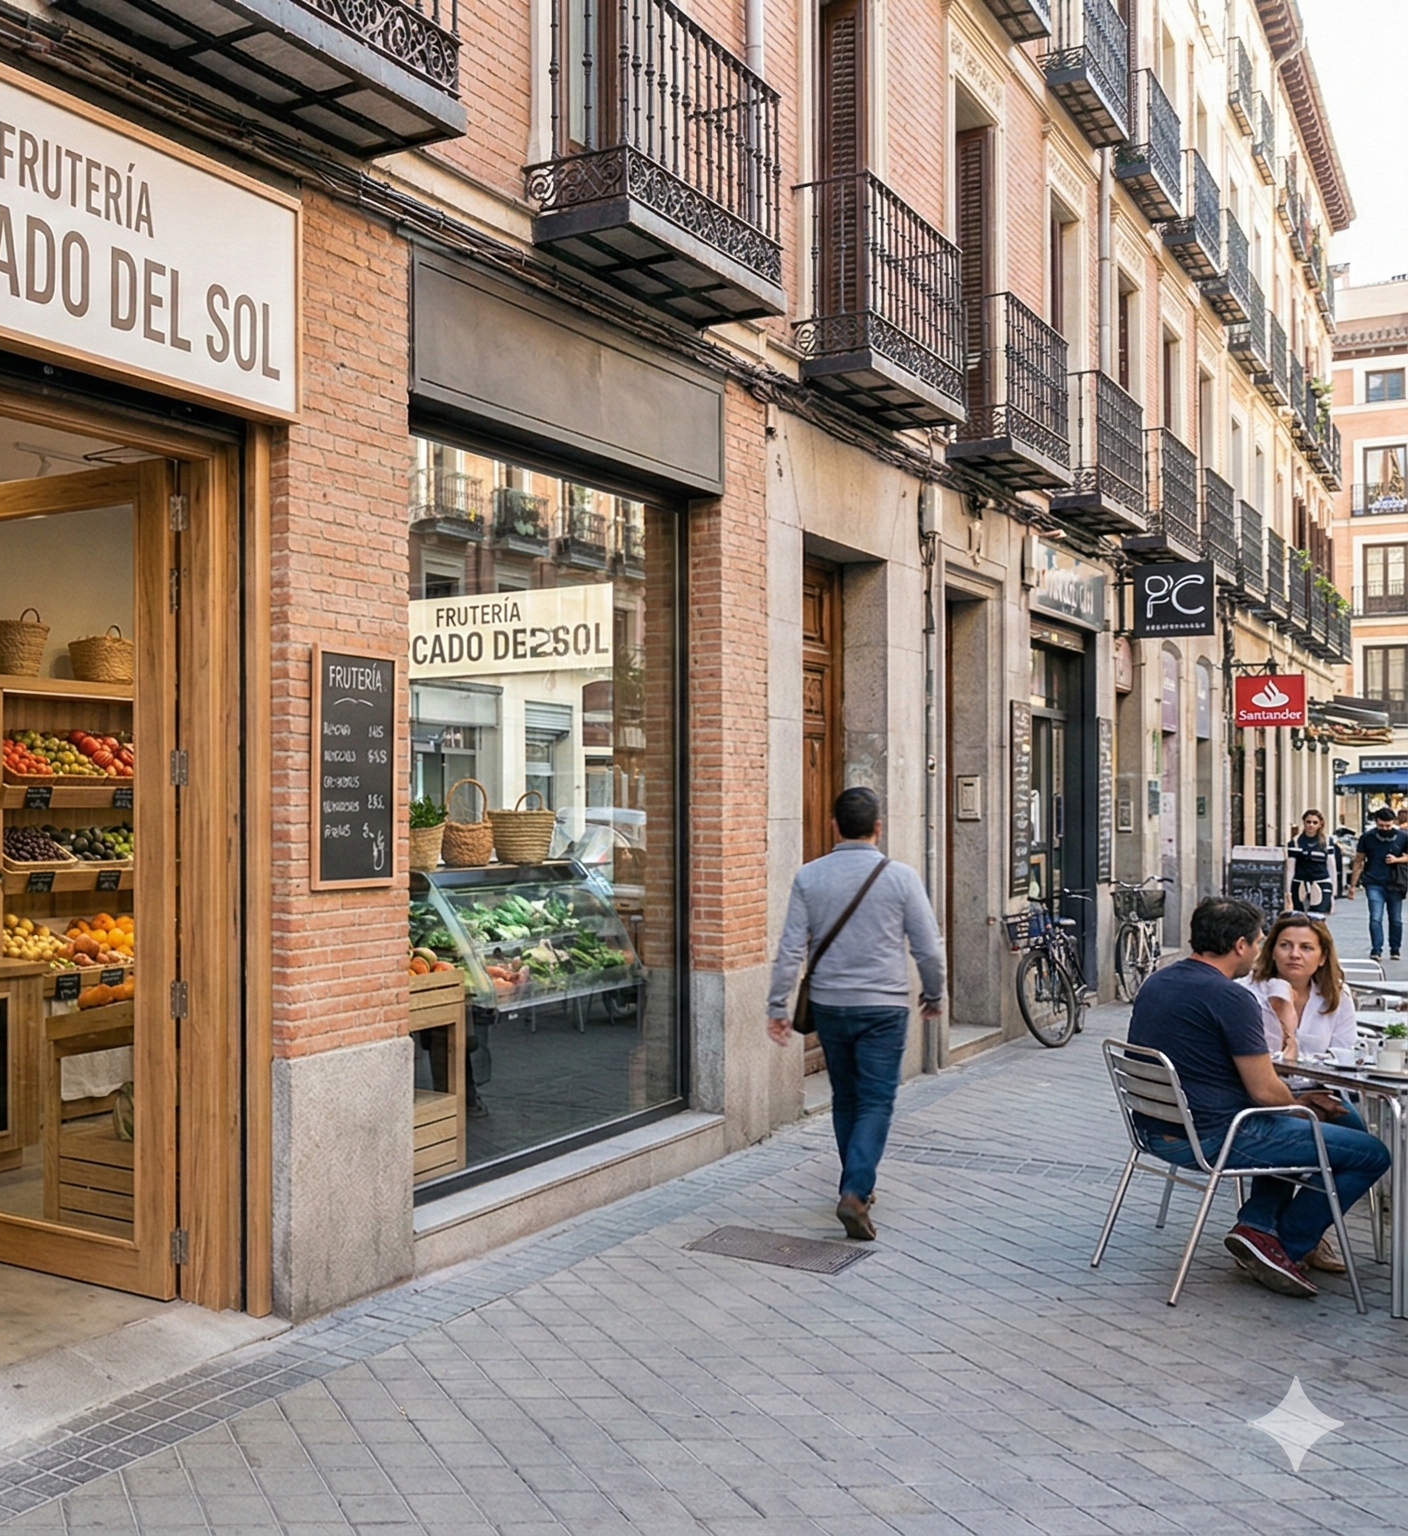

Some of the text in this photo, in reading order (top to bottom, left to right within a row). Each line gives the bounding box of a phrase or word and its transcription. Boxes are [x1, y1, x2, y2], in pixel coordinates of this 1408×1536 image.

[108, 244, 192, 354] DEL
[205, 282, 281, 382] SOL
[435, 595, 522, 628] FRUTERÍA
[328, 662, 383, 693] FRUTERÍA
[1238, 707, 1303, 722] Santander
